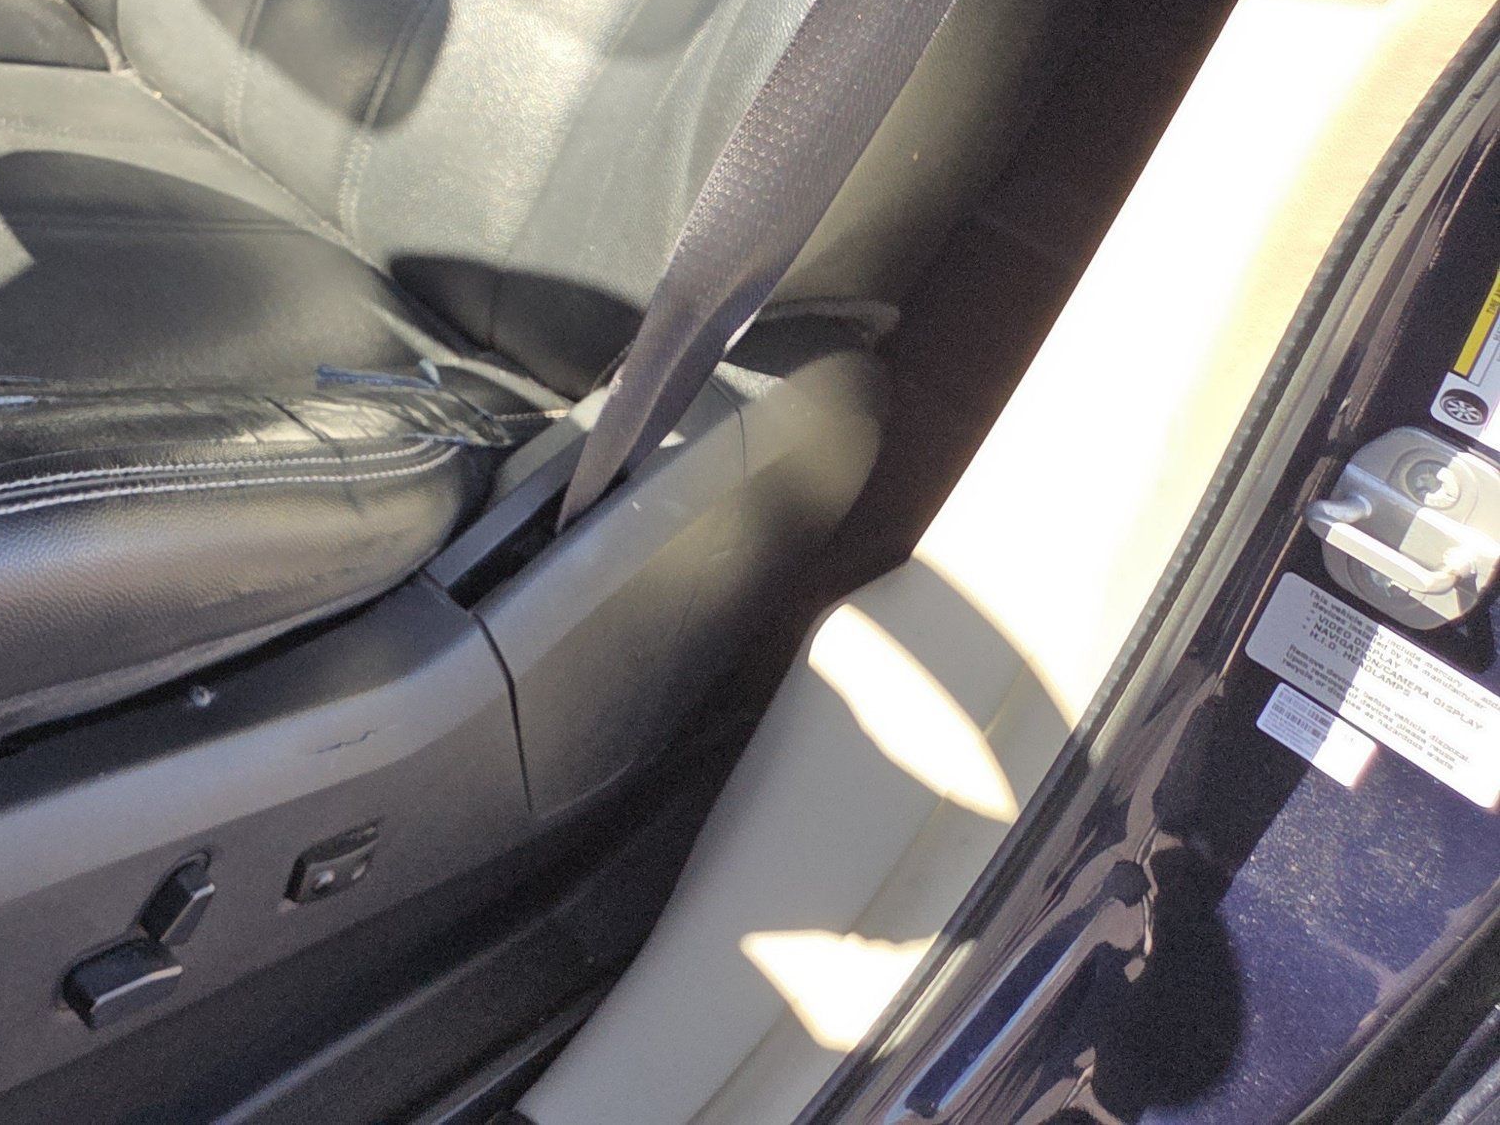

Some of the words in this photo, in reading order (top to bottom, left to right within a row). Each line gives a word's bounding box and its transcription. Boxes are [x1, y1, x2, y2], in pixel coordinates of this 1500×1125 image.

[1309, 590, 1328, 604] This
[1330, 603, 1363, 625] vehicle
[1316, 614, 1352, 639] VIDEO
[1353, 636, 1400, 669] DISPLAY
[1313, 622, 1430, 698] NAVIGATION/CAMERA
[1432, 696, 1482, 731] DISPLAY
[1342, 651, 1410, 696] HEADLAMPS
